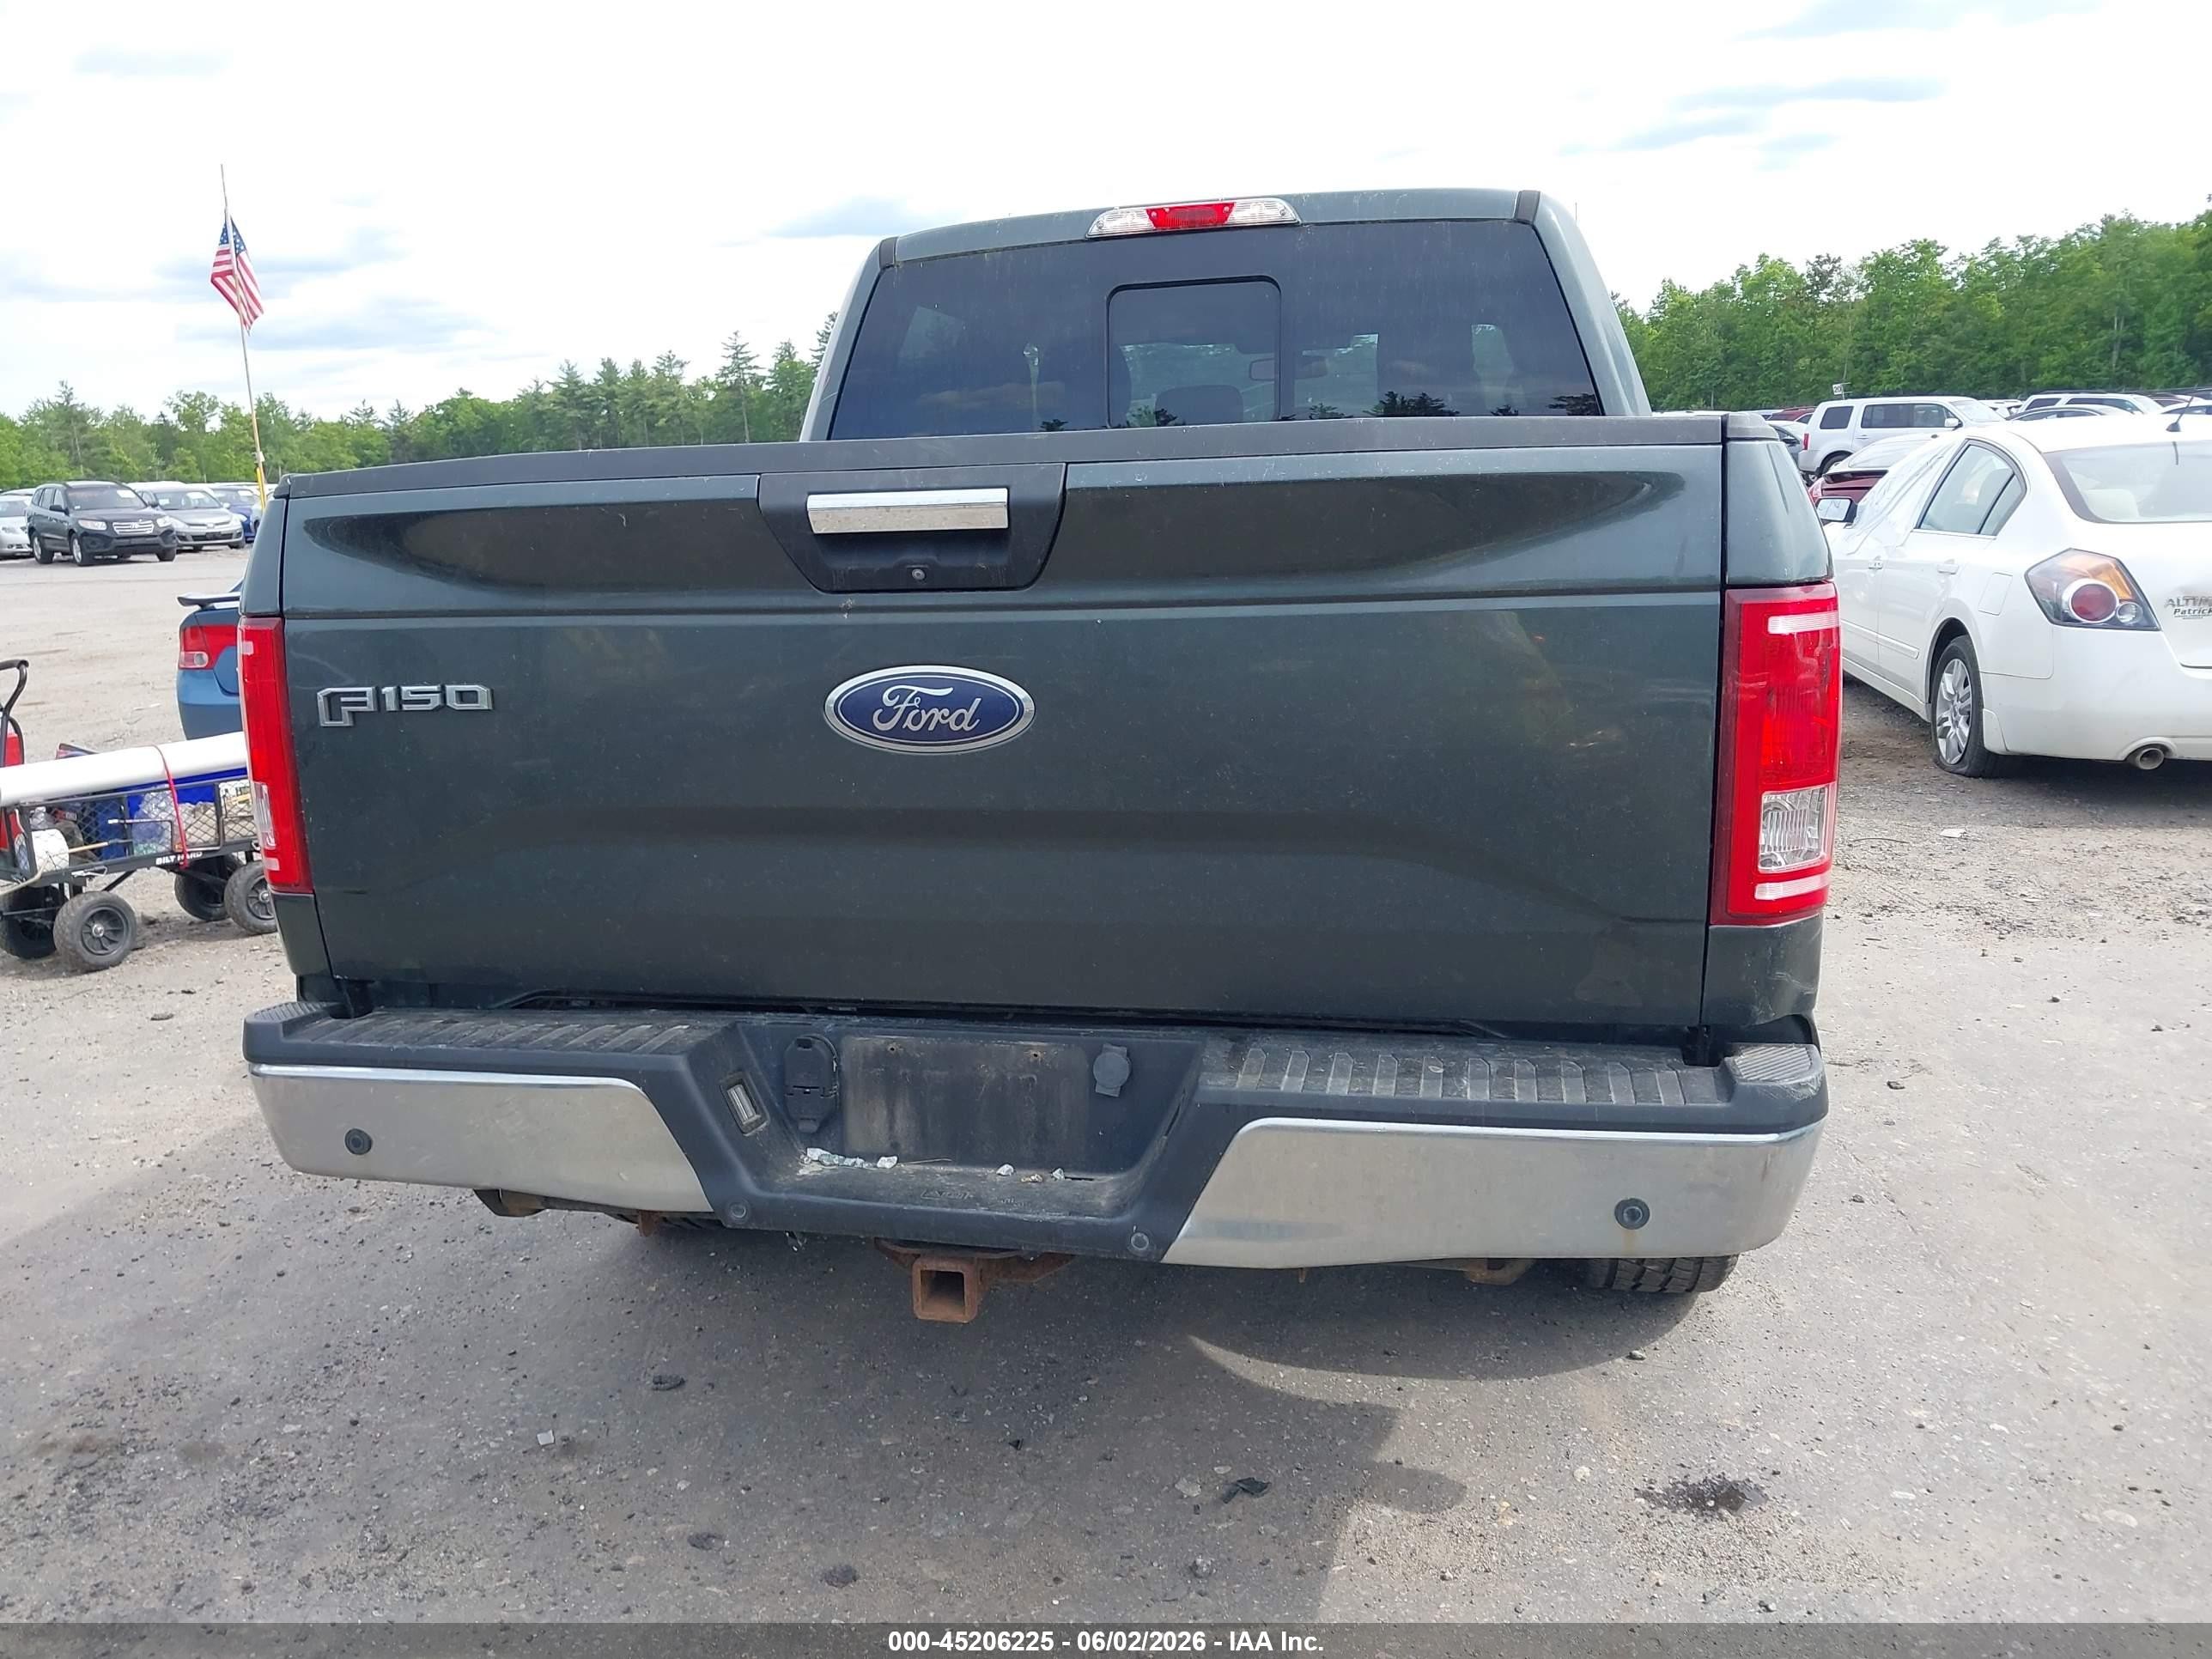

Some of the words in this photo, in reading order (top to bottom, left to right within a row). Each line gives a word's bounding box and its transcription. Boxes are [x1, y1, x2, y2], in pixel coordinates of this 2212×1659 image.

[317, 684, 493, 726] F150
[872, 685, 981, 731] Ford
[155, 855, 176, 866] BILT
